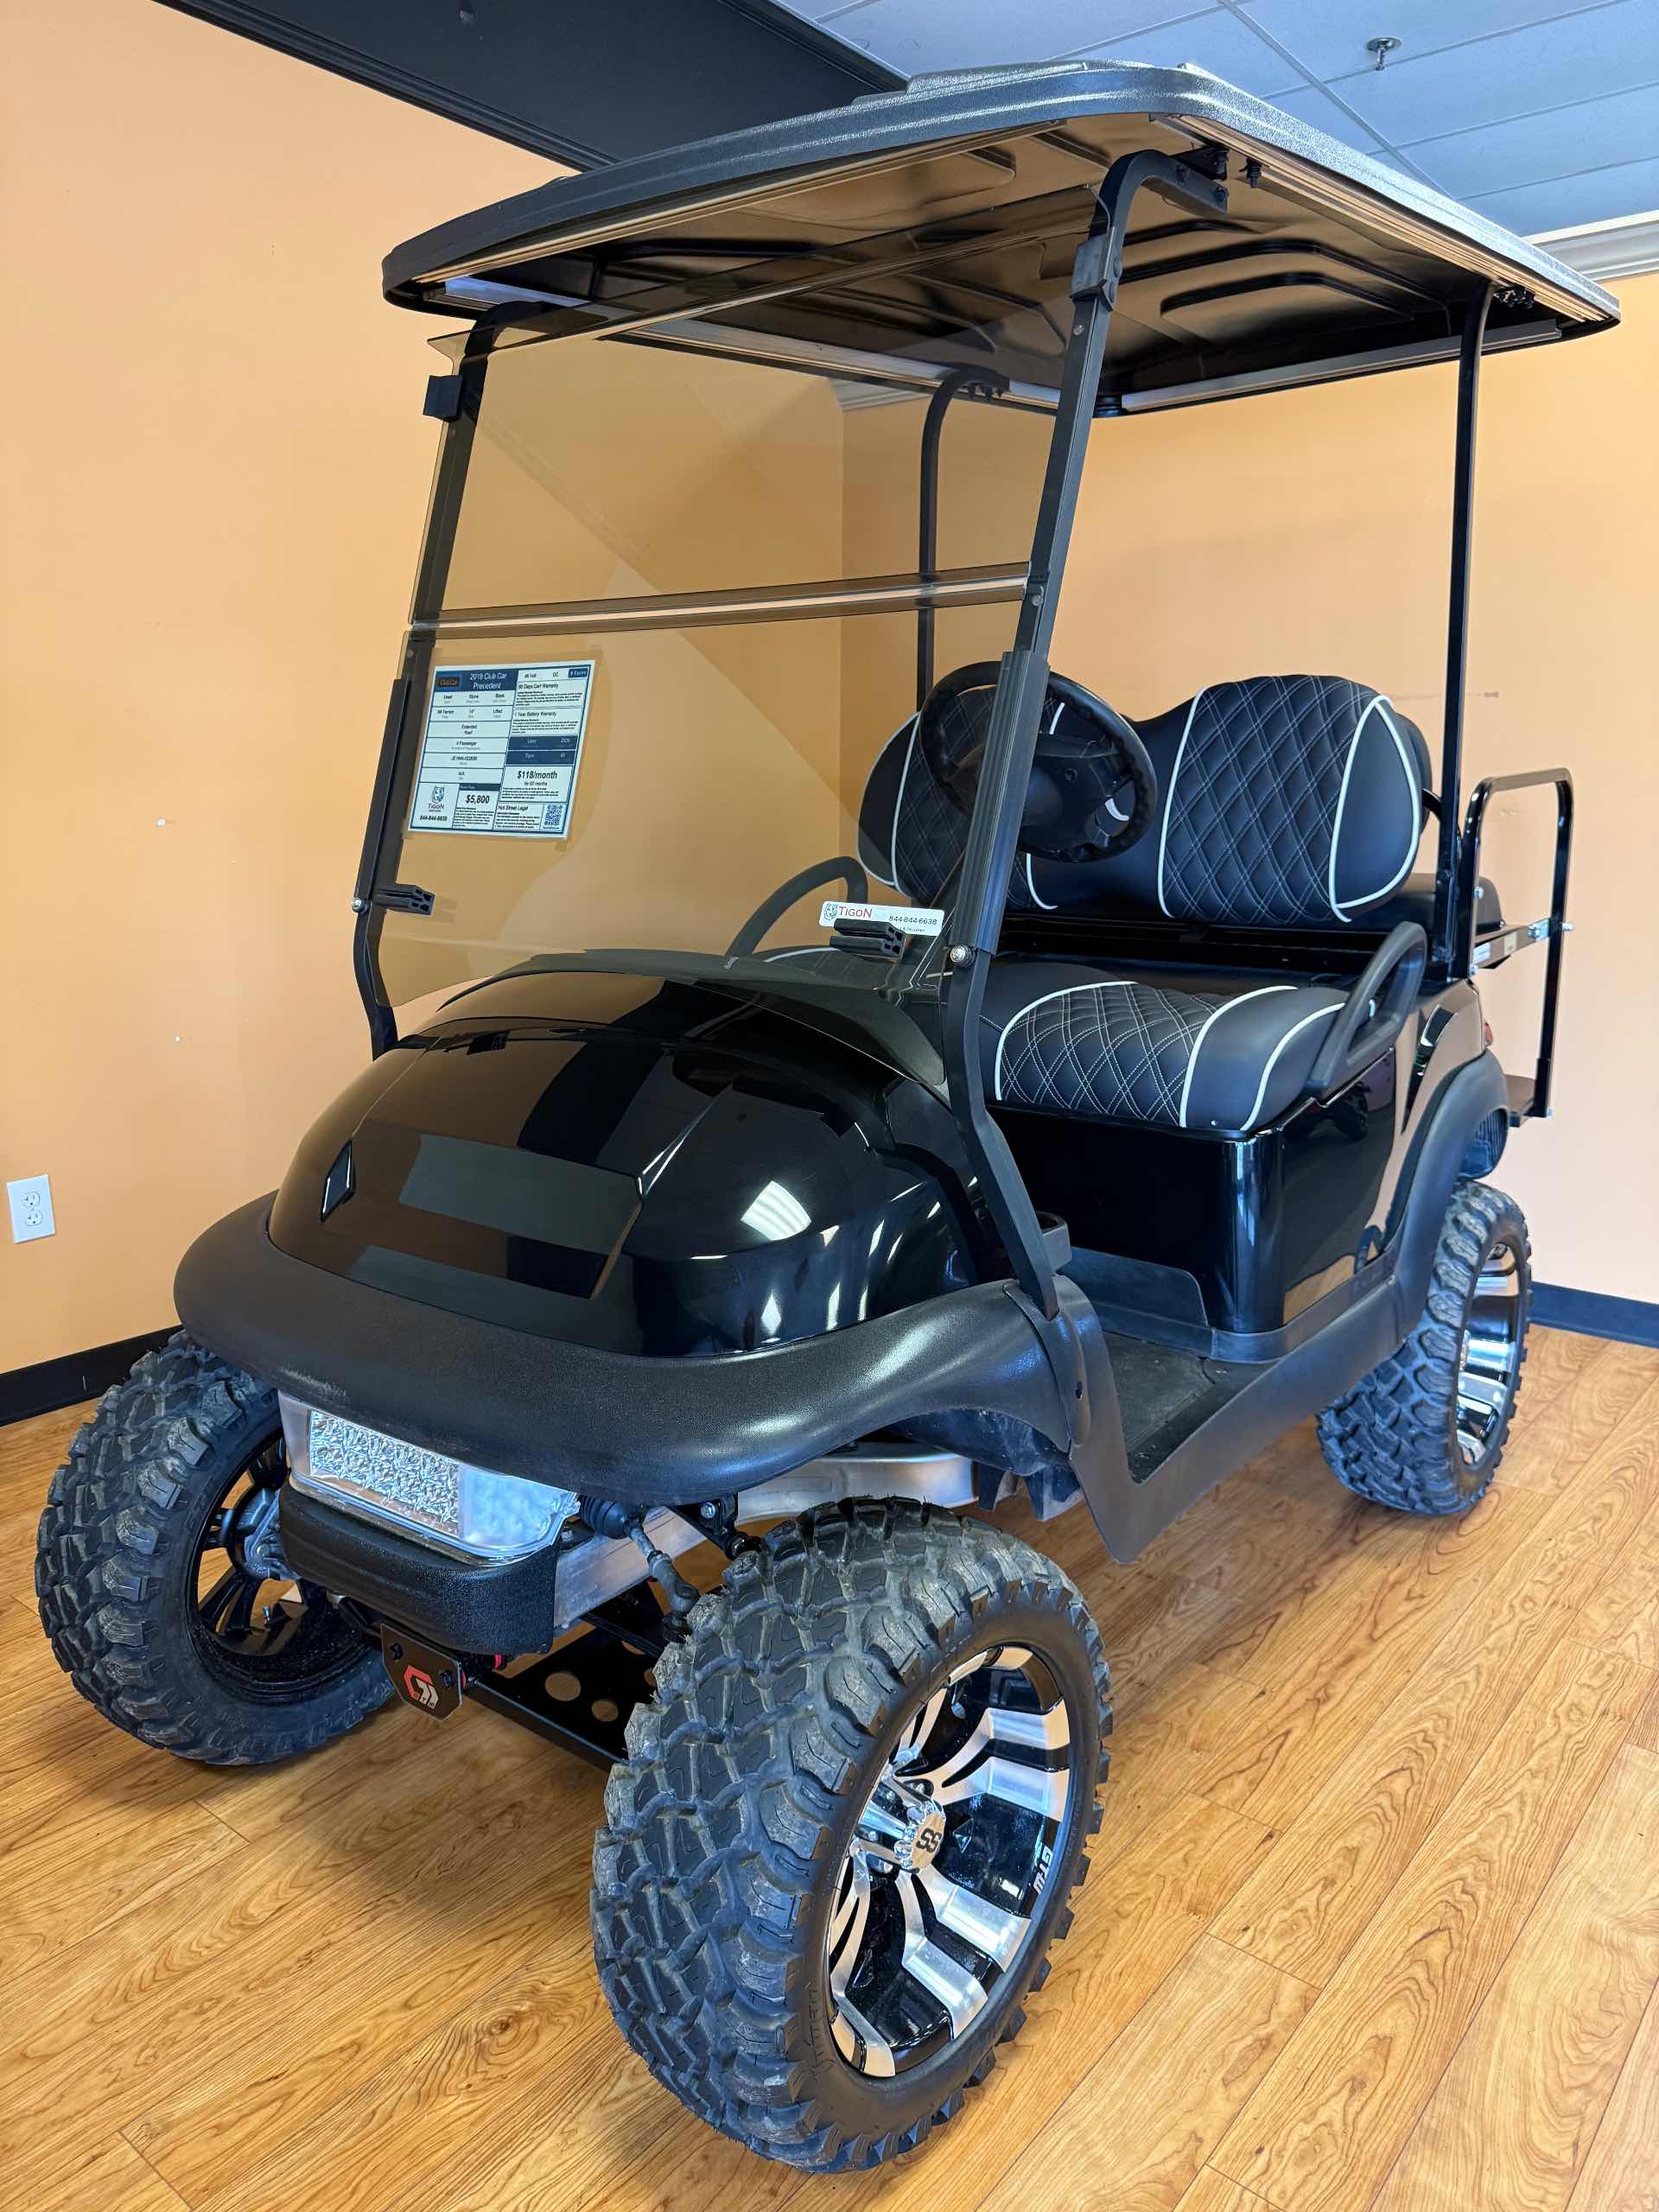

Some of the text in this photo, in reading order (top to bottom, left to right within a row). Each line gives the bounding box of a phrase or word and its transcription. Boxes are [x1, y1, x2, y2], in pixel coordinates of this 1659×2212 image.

[517, 770, 558, 779] $118/month
[466, 794, 490, 804] $5,800
[889, 915, 938, 925] 844-844-6638
